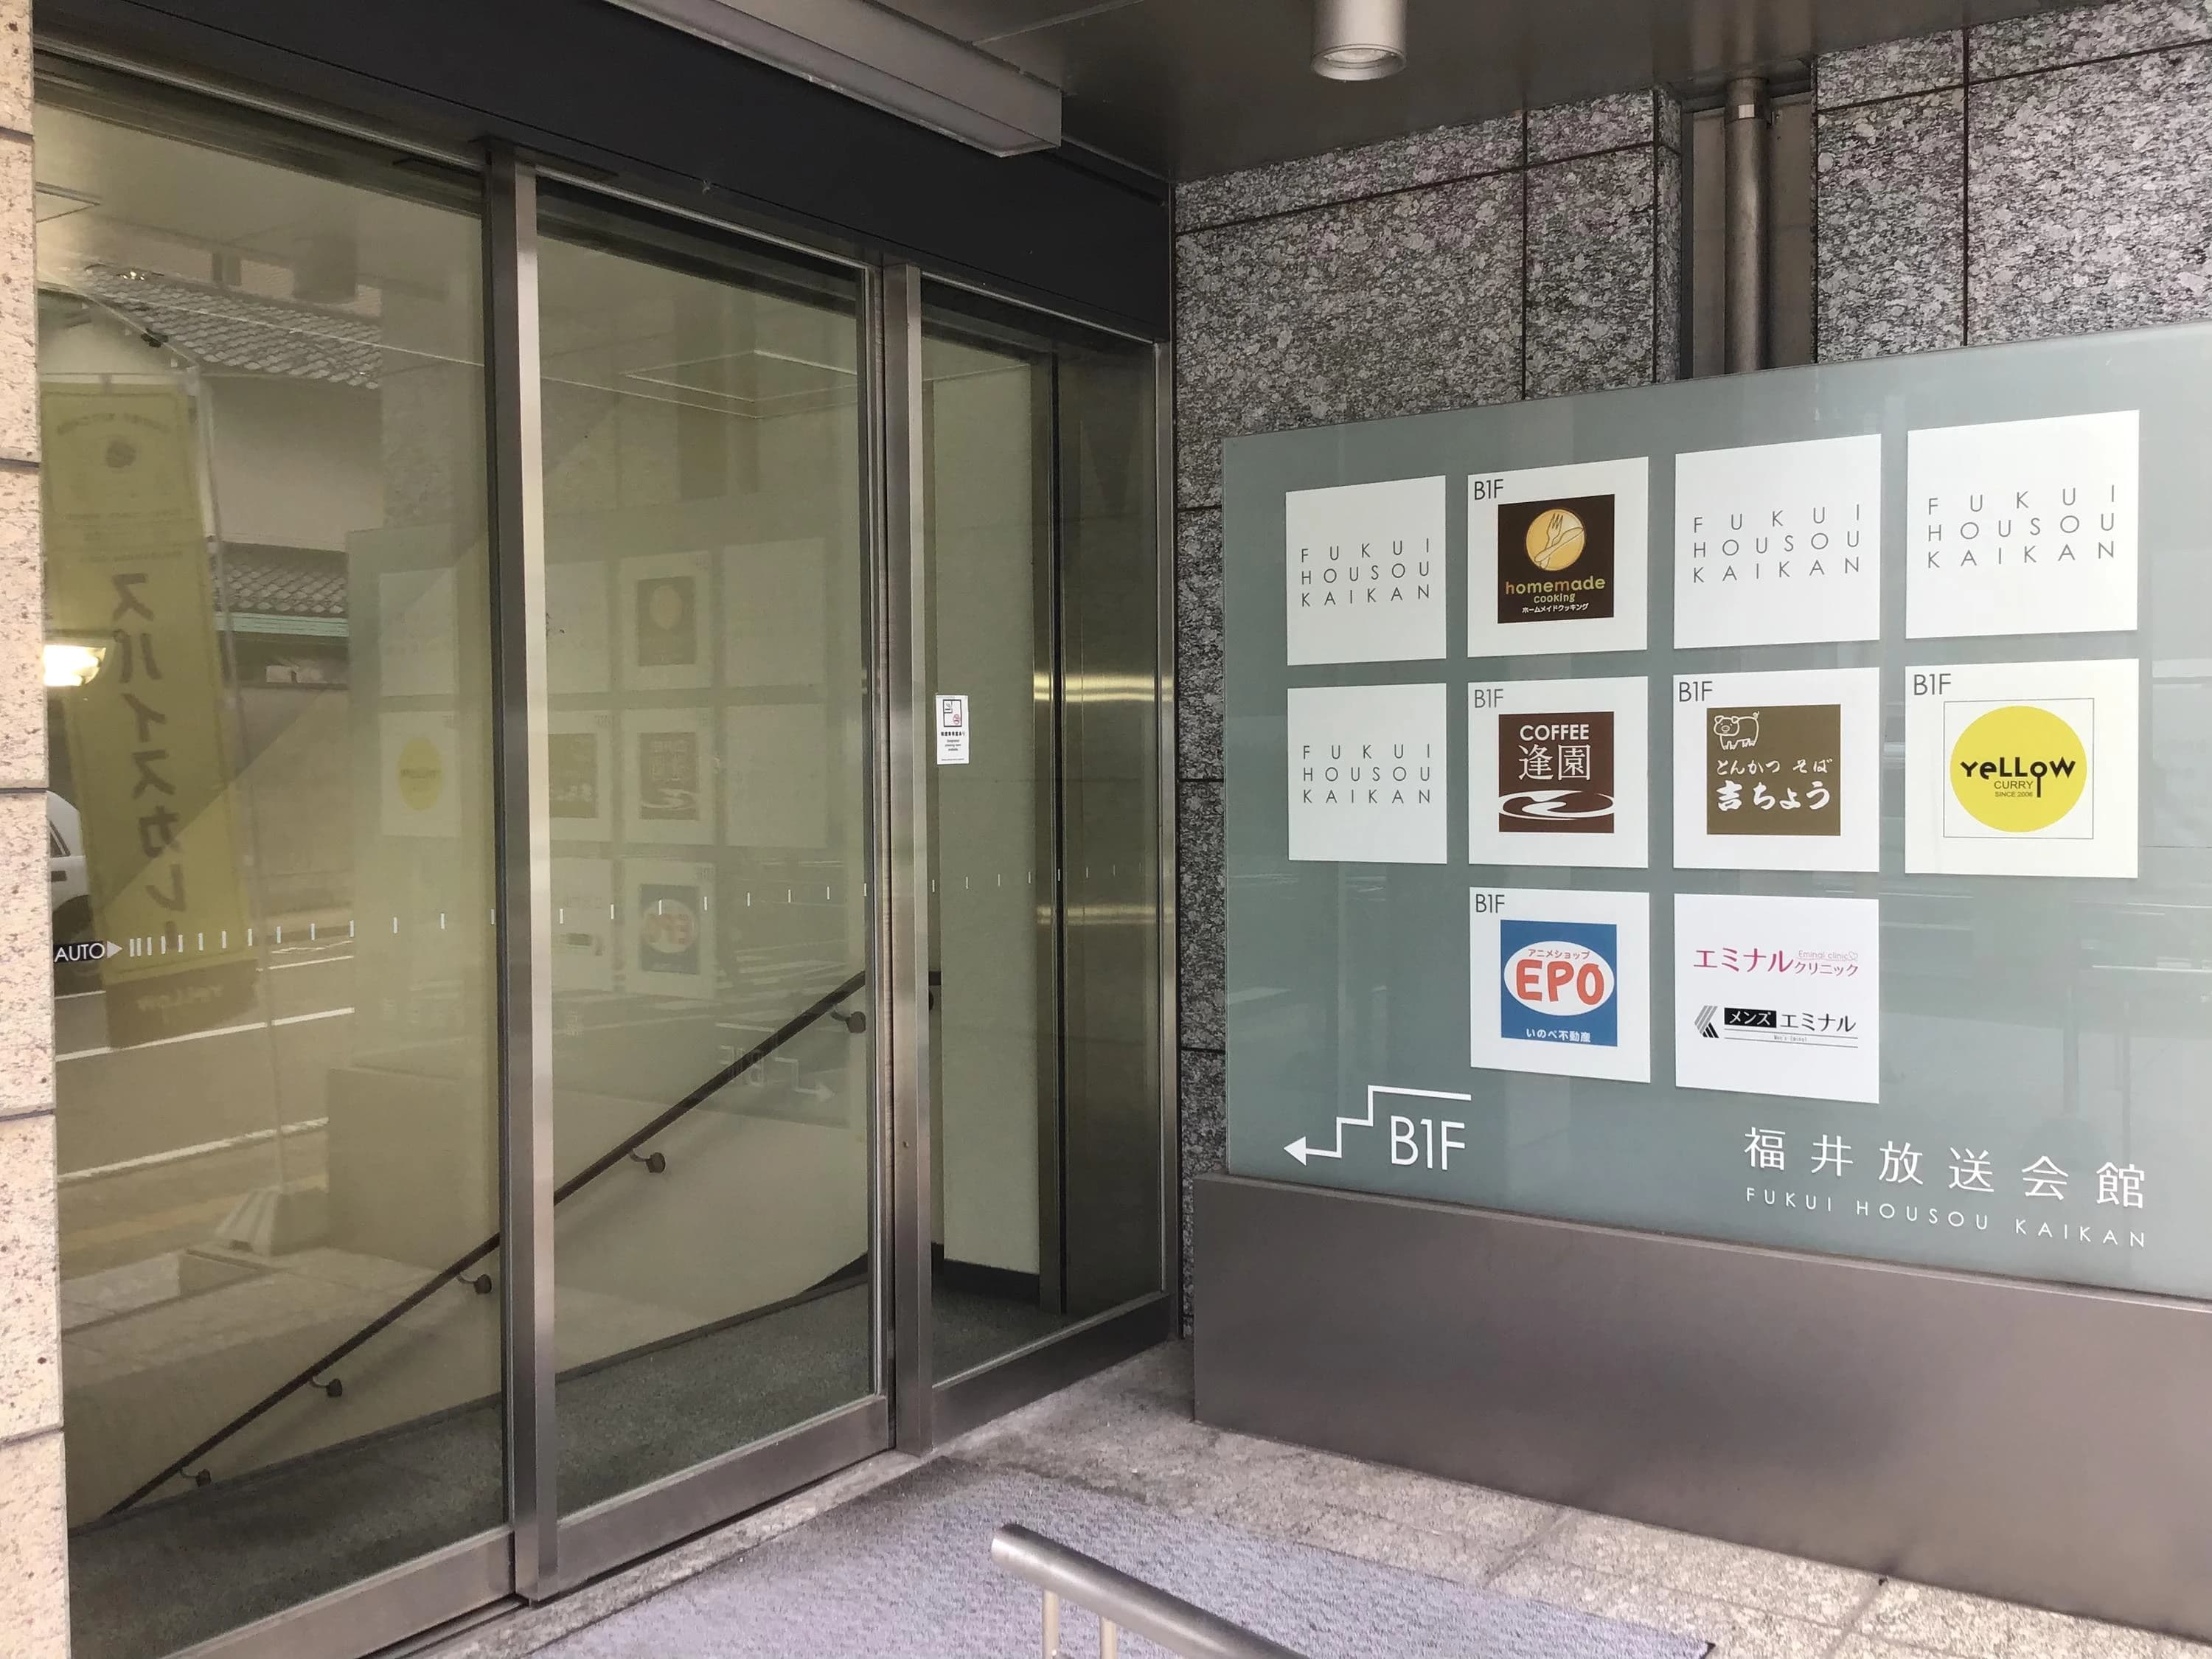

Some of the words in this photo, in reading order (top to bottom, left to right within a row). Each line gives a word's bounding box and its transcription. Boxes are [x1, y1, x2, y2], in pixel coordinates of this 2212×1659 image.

[1473, 479, 1504, 501] B1F
[1928, 484, 2115, 515] FUKUI
[1694, 504, 1860, 533] FUKUI
[1928, 513, 2115, 543] HOUSOU
[1301, 538, 1430, 563] FUKUI
[1694, 531, 1860, 558] HOUSOU
[1927, 543, 2115, 569] KAIKAN
[1301, 561, 1430, 585] HOUSOU
[1694, 557, 1860, 584] KAIKAN
[1505, 576, 1605, 594] homemade
[1301, 585, 1430, 608] KAIKAN
[1534, 593, 1576, 603] cooking
[1522, 603, 1589, 613] ホームメイドクッキング
[1678, 681, 1713, 702] B1F
[1913, 673, 1952, 696] B1F
[1473, 689, 1504, 709] B1F
[1520, 724, 1589, 741] COFFEE
[1303, 743, 1430, 759] FUKUI
[1518, 744, 1591, 780] 逢園
[1303, 766, 1430, 782] HOUSOU
[1717, 759, 1781, 776] とんかつ
[1792, 758, 1833, 773] そば
[1303, 789, 1430, 804] KAIKAN
[1716, 779, 1831, 812] 吉ちょう
[1994, 781, 2034, 790] CURRY
[1475, 894, 1505, 914] B1F
[54, 942, 105, 963] AUTO
[1528, 948, 1590, 960] アニメショップ
[1693, 947, 1794, 973] エミナル
[1794, 961, 1859, 977] クリニック
[1516, 959, 1604, 1006] EPO
[1729, 1010, 1772, 1026] メンズ
[1780, 1012, 1857, 1032] エミナル
[1526, 1028, 1591, 1043] いのべ不動産
[1391, 1114, 1466, 1170] B1F
[1744, 1126, 2146, 1208] 福井放送会館
[1746, 1187, 1832, 1212] FUKUI
[1857, 1200, 1988, 1230] HOUSOU
[2016, 1220, 2145, 1248] KAIKAN
